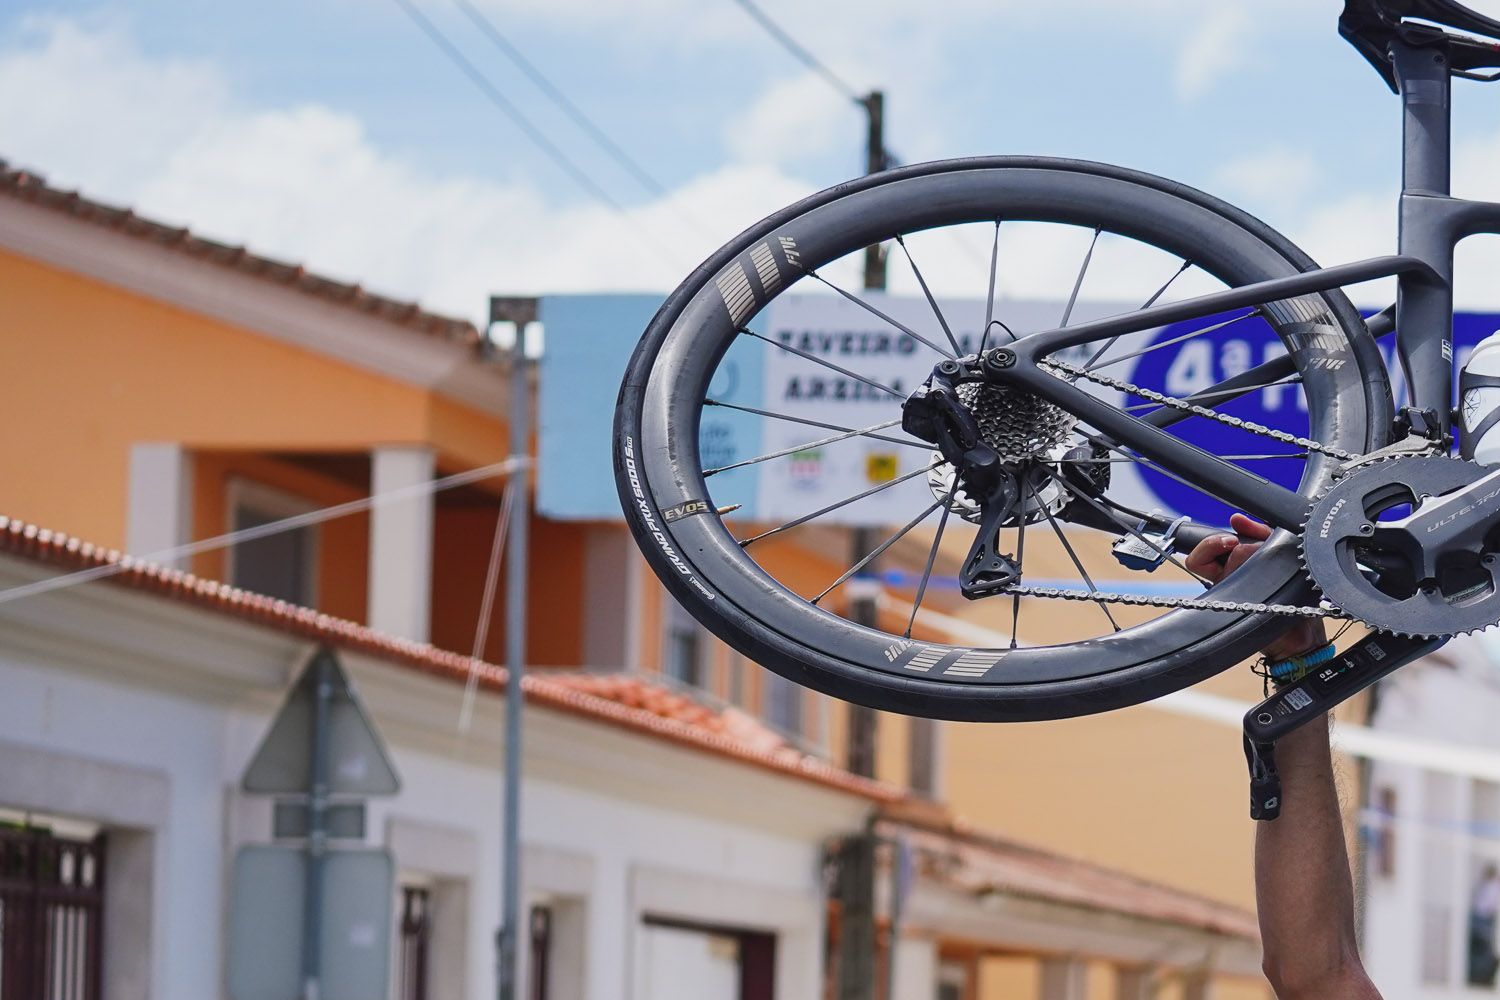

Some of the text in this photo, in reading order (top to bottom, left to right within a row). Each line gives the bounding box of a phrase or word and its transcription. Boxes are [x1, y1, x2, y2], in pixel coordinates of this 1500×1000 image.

[637, 499, 660, 535] PRIX
[1320, 498, 1347, 538] ROTOR
[657, 533, 692, 575] GRAND
